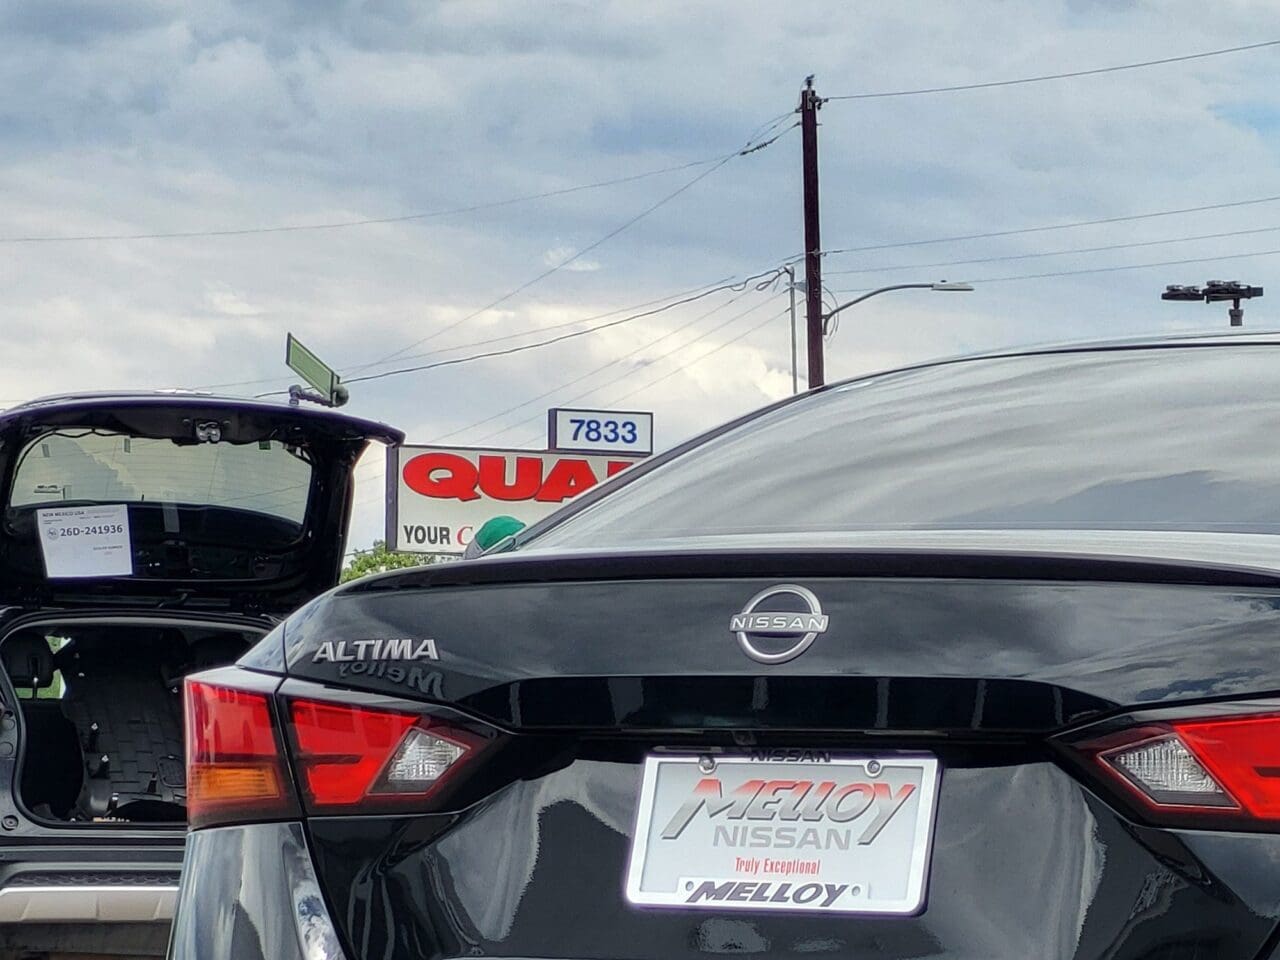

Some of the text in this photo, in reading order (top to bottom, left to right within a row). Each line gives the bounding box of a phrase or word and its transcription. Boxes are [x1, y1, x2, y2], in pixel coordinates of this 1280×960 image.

[569, 418, 638, 444] 7833
[60, 524, 123, 537] 26D-241936
[403, 525, 451, 545] YOUR
[732, 616, 825, 630] NISSAN
[312, 639, 440, 662] ALTIMA
[750, 749, 831, 763] NISSAN
[661, 778, 916, 845] MELLOY
[713, 825, 851, 850] NISSAN
[735, 856, 821, 876] Truly Exceptional
[685, 880, 850, 908] MELLOY
